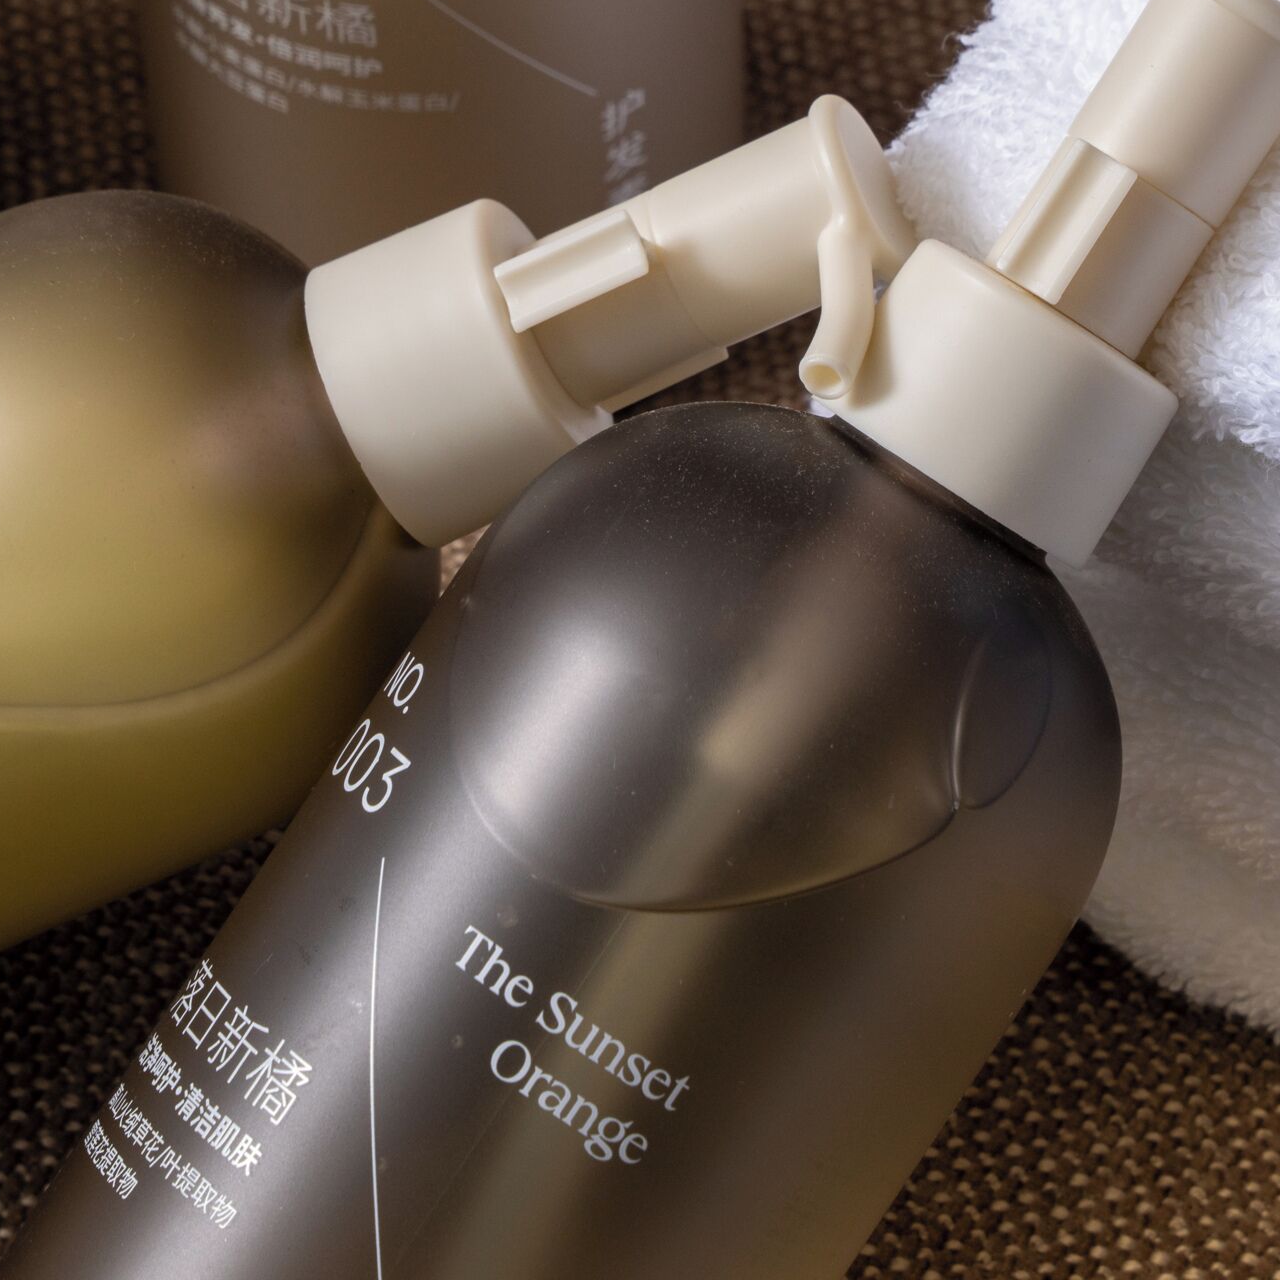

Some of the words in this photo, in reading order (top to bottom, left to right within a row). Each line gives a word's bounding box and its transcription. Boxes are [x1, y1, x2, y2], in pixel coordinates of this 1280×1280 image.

[383, 651, 425, 714] NO.
[332, 718, 411, 813] 003
[169, 958, 313, 1126] 落日新橘
[455, 924, 534, 1008] The
[535, 990, 691, 1112] Sunset
[489, 1039, 648, 1166] Orange
